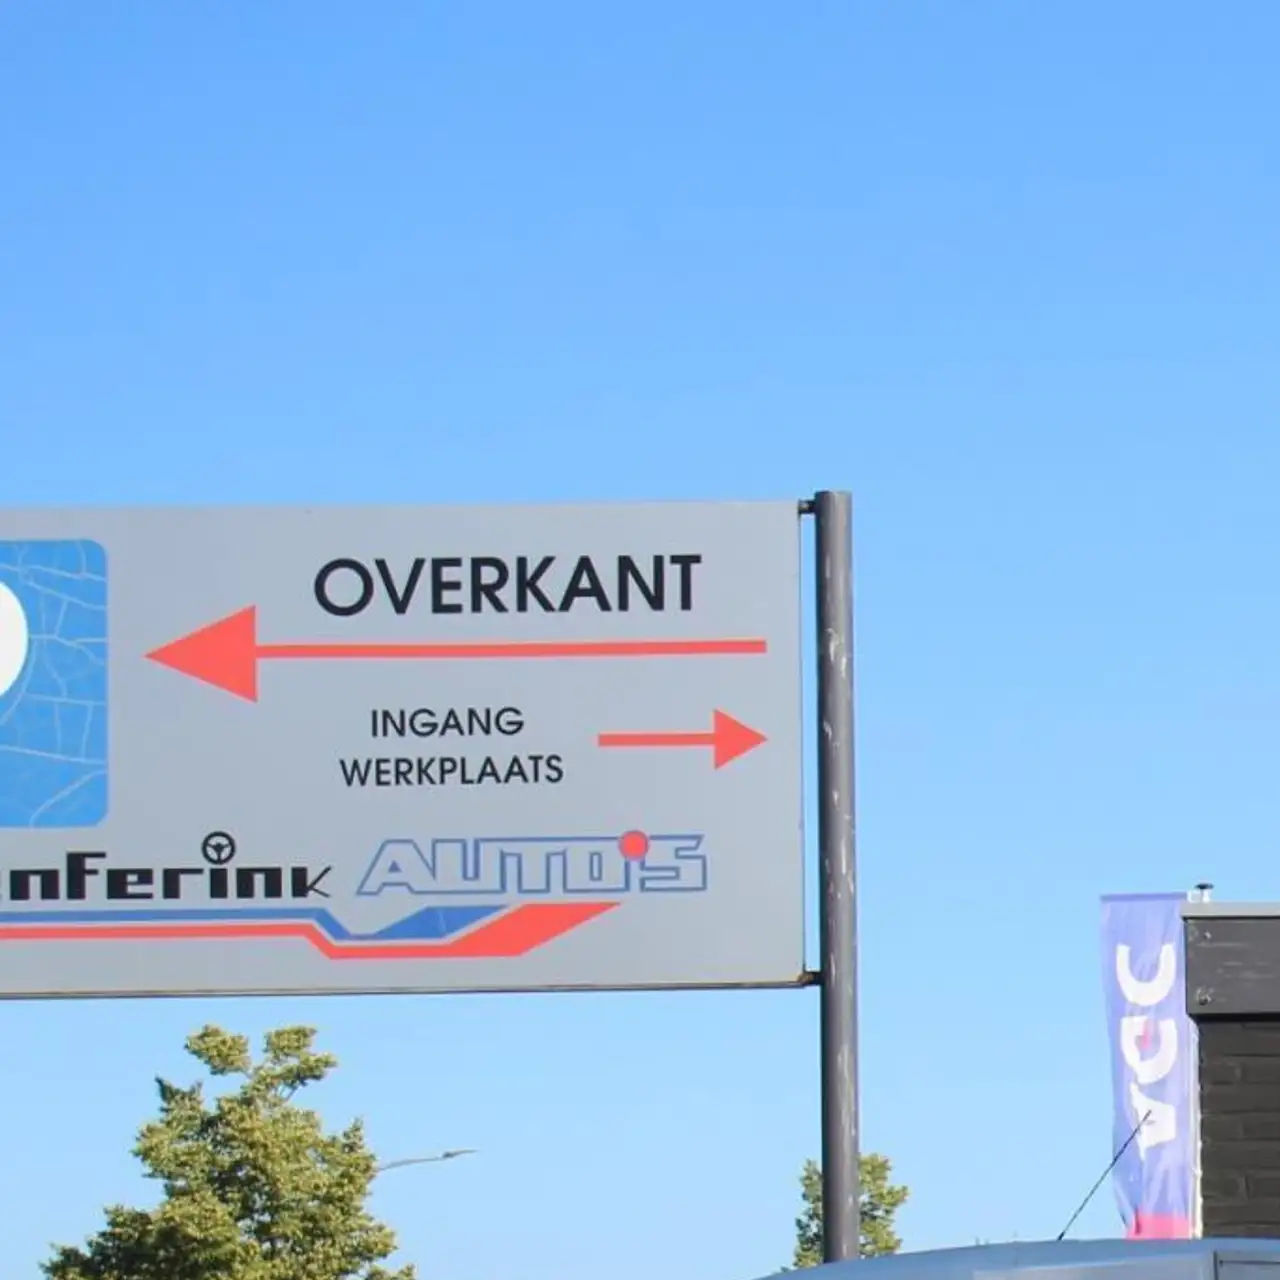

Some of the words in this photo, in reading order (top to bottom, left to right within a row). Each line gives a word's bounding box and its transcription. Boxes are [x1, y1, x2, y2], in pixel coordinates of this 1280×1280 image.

[314, 554, 702, 617] OVERKANT
[370, 706, 525, 739] INGANG
[339, 754, 565, 788] WERKPLAATS
